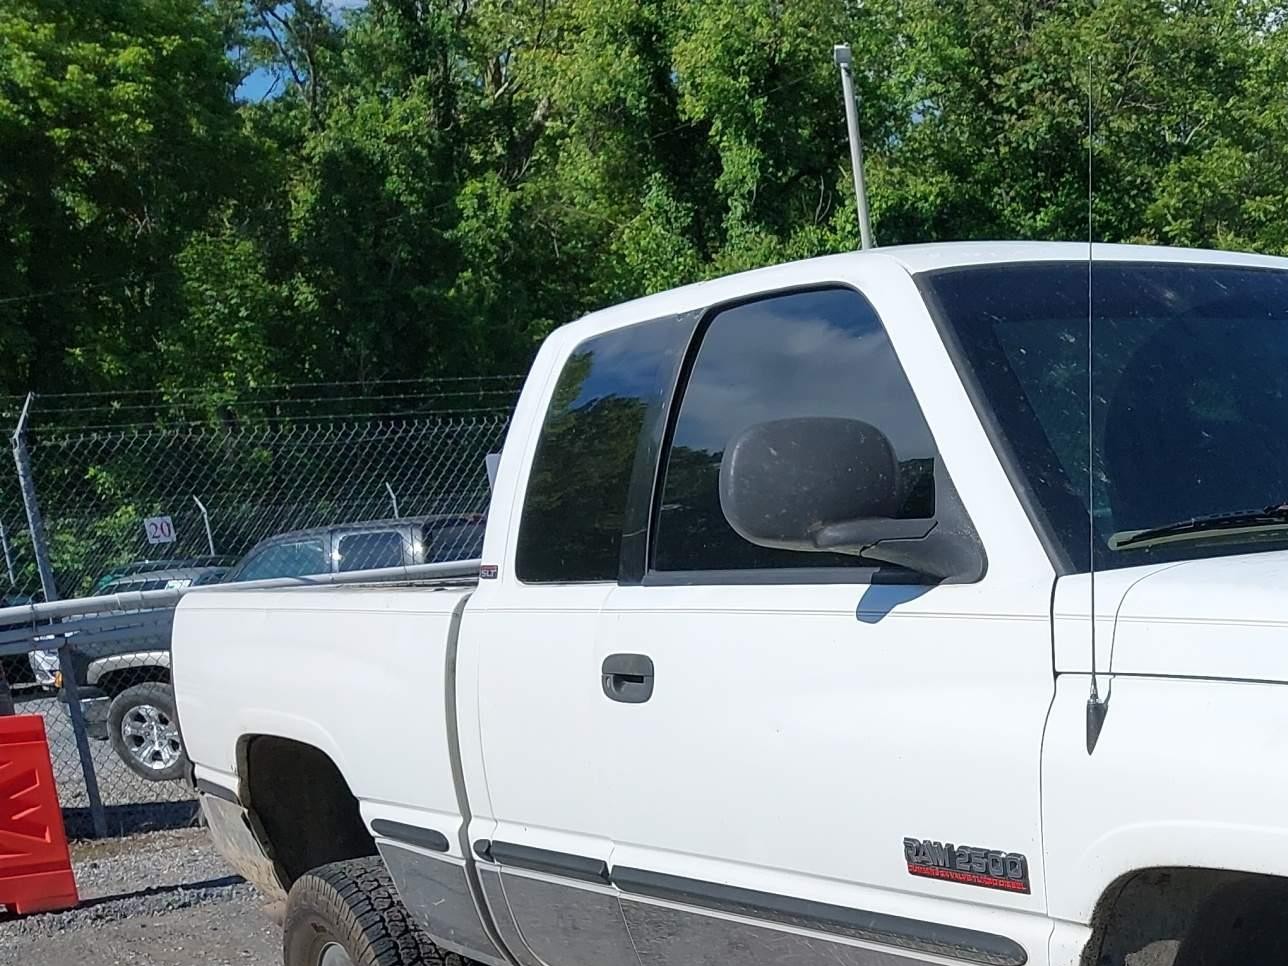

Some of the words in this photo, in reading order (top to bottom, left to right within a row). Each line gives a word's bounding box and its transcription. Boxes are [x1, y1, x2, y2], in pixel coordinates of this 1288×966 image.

[150, 521, 172, 539] 20
[904, 837, 955, 867] RAM
[955, 846, 1025, 879] 2500
